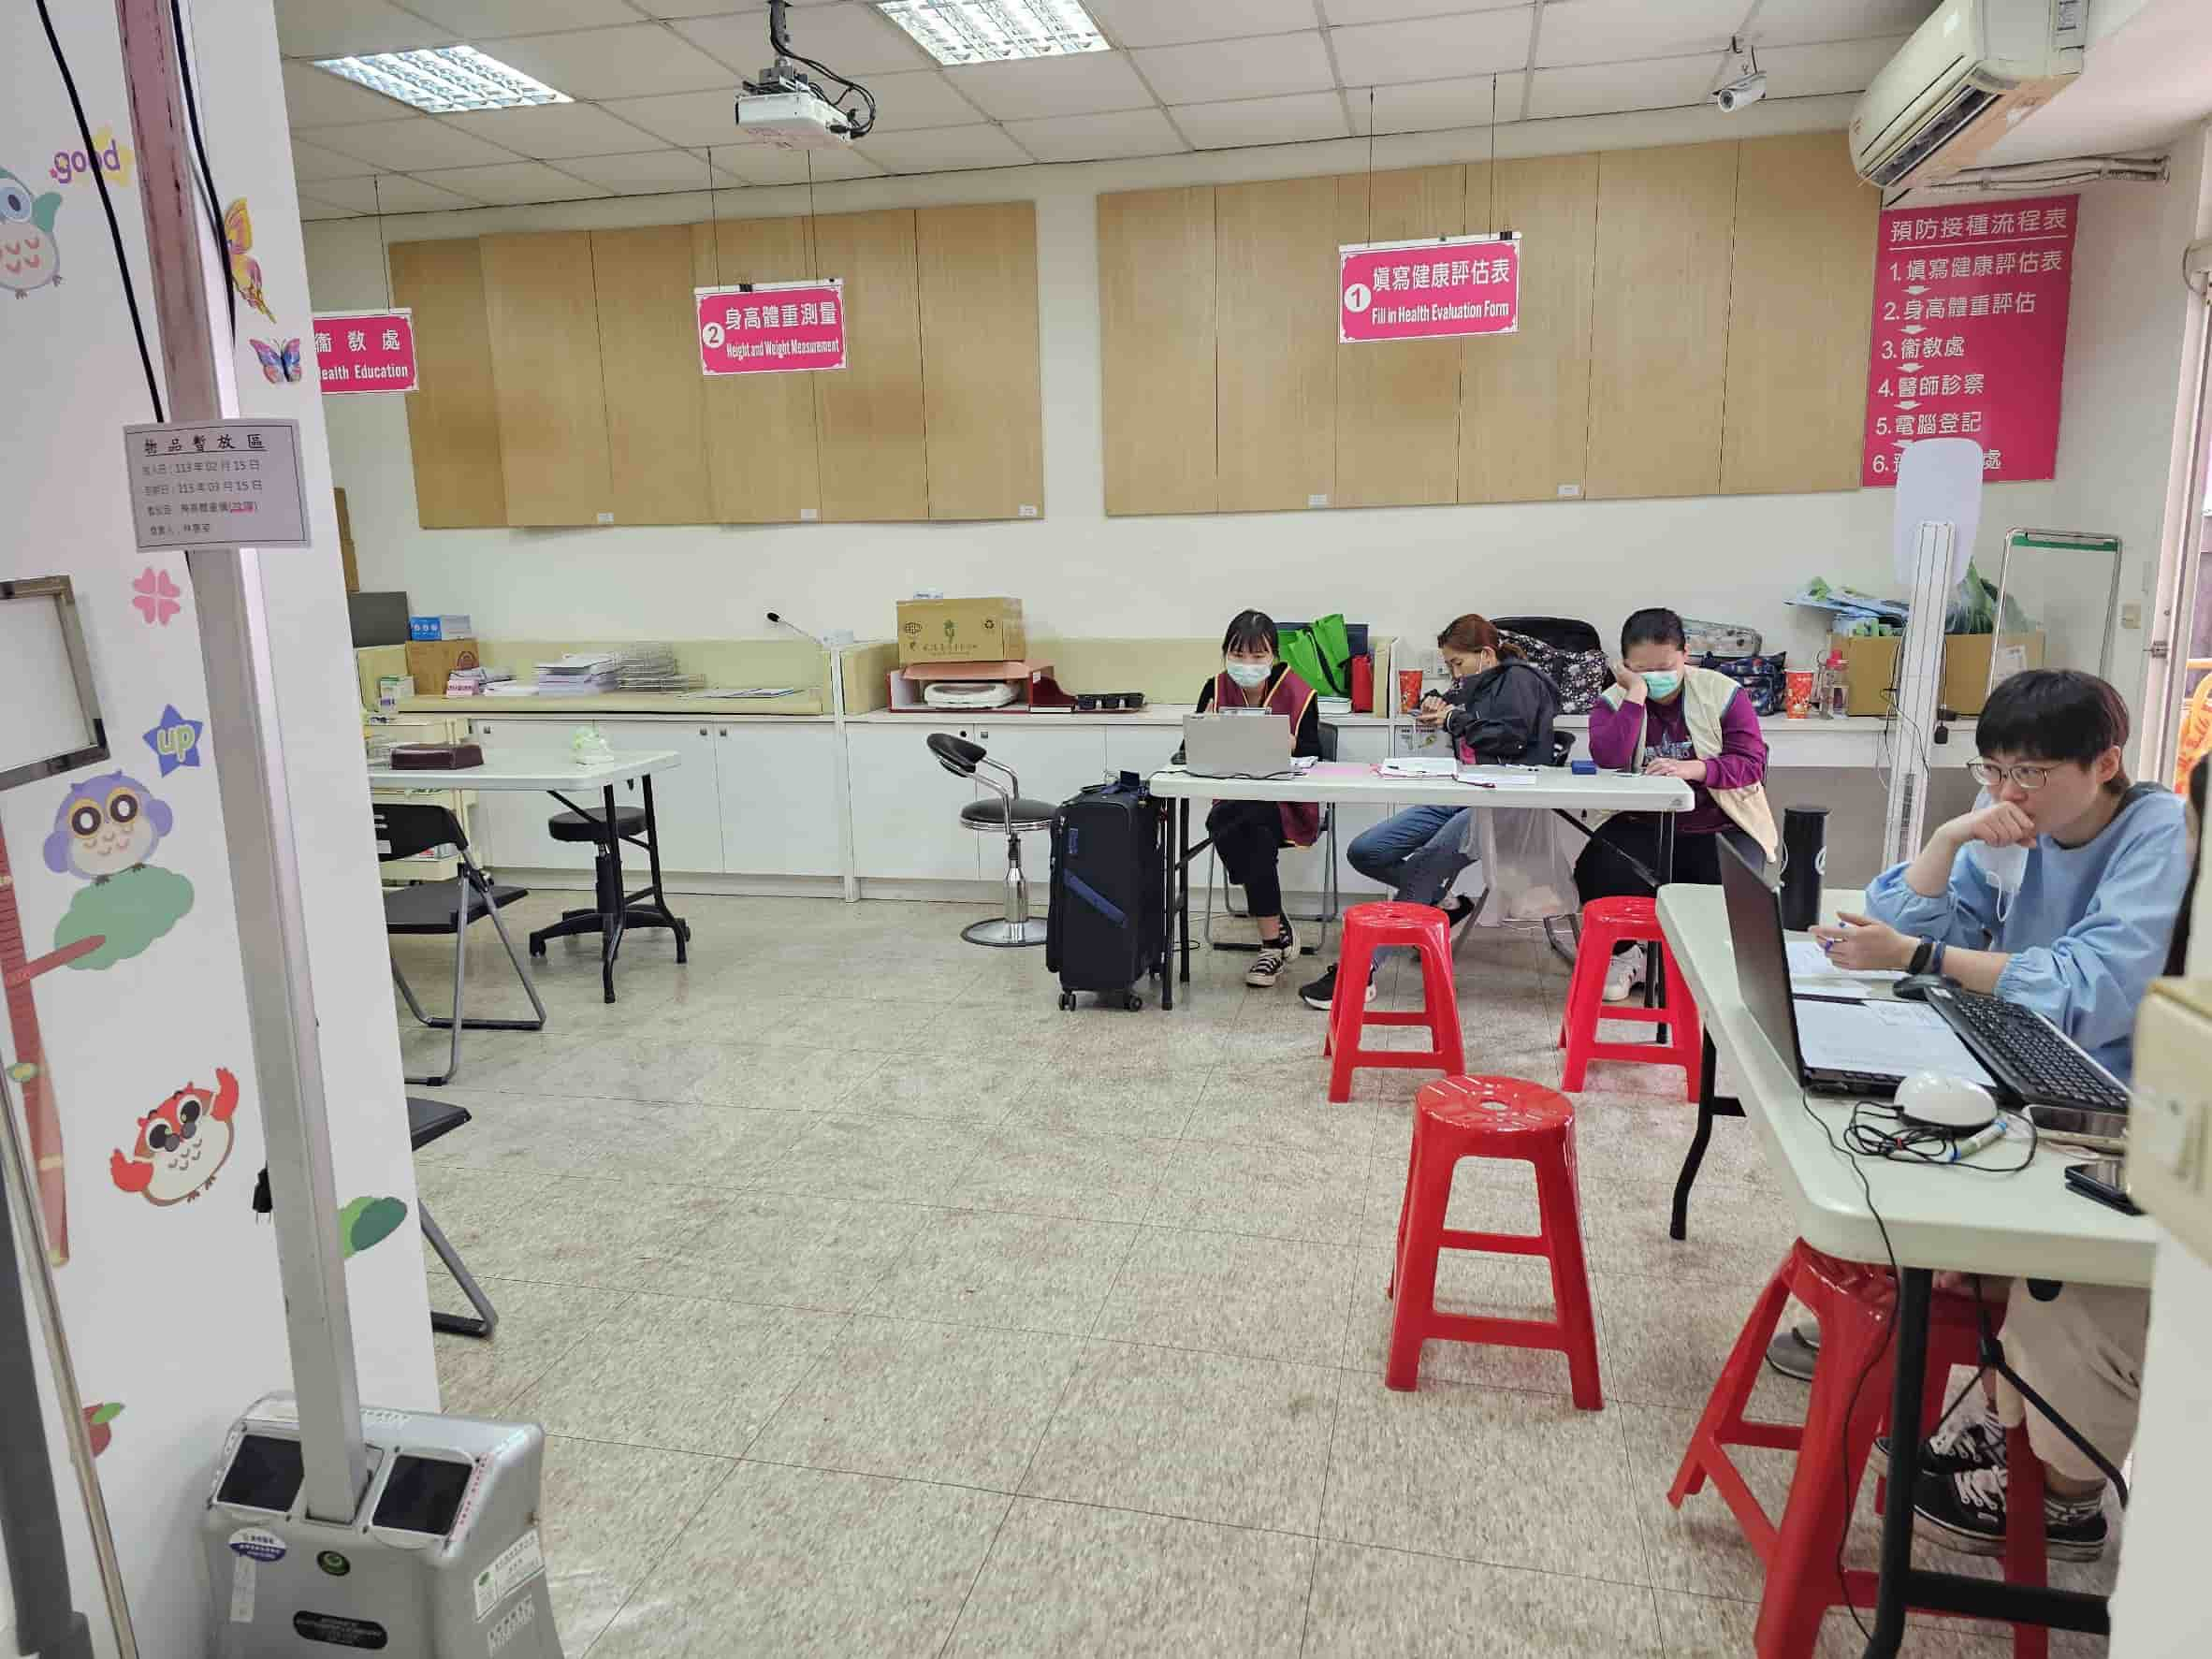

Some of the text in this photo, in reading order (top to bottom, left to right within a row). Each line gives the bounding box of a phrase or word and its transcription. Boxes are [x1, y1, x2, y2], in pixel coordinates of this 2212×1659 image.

[1890, 209, 2068, 242] 預防接種流程表
[1350, 287, 1361, 308] 1
[725, 301, 837, 330] 身高體重測量
[1372, 299, 1509, 325] Fill in Health Evaluation Form
[707, 326, 720, 343] 2
[726, 337, 840, 360] Height and Weight Measurement
[319, 363, 408, 380] ealth Education
[144, 433, 266, 455] 物品暫放區
